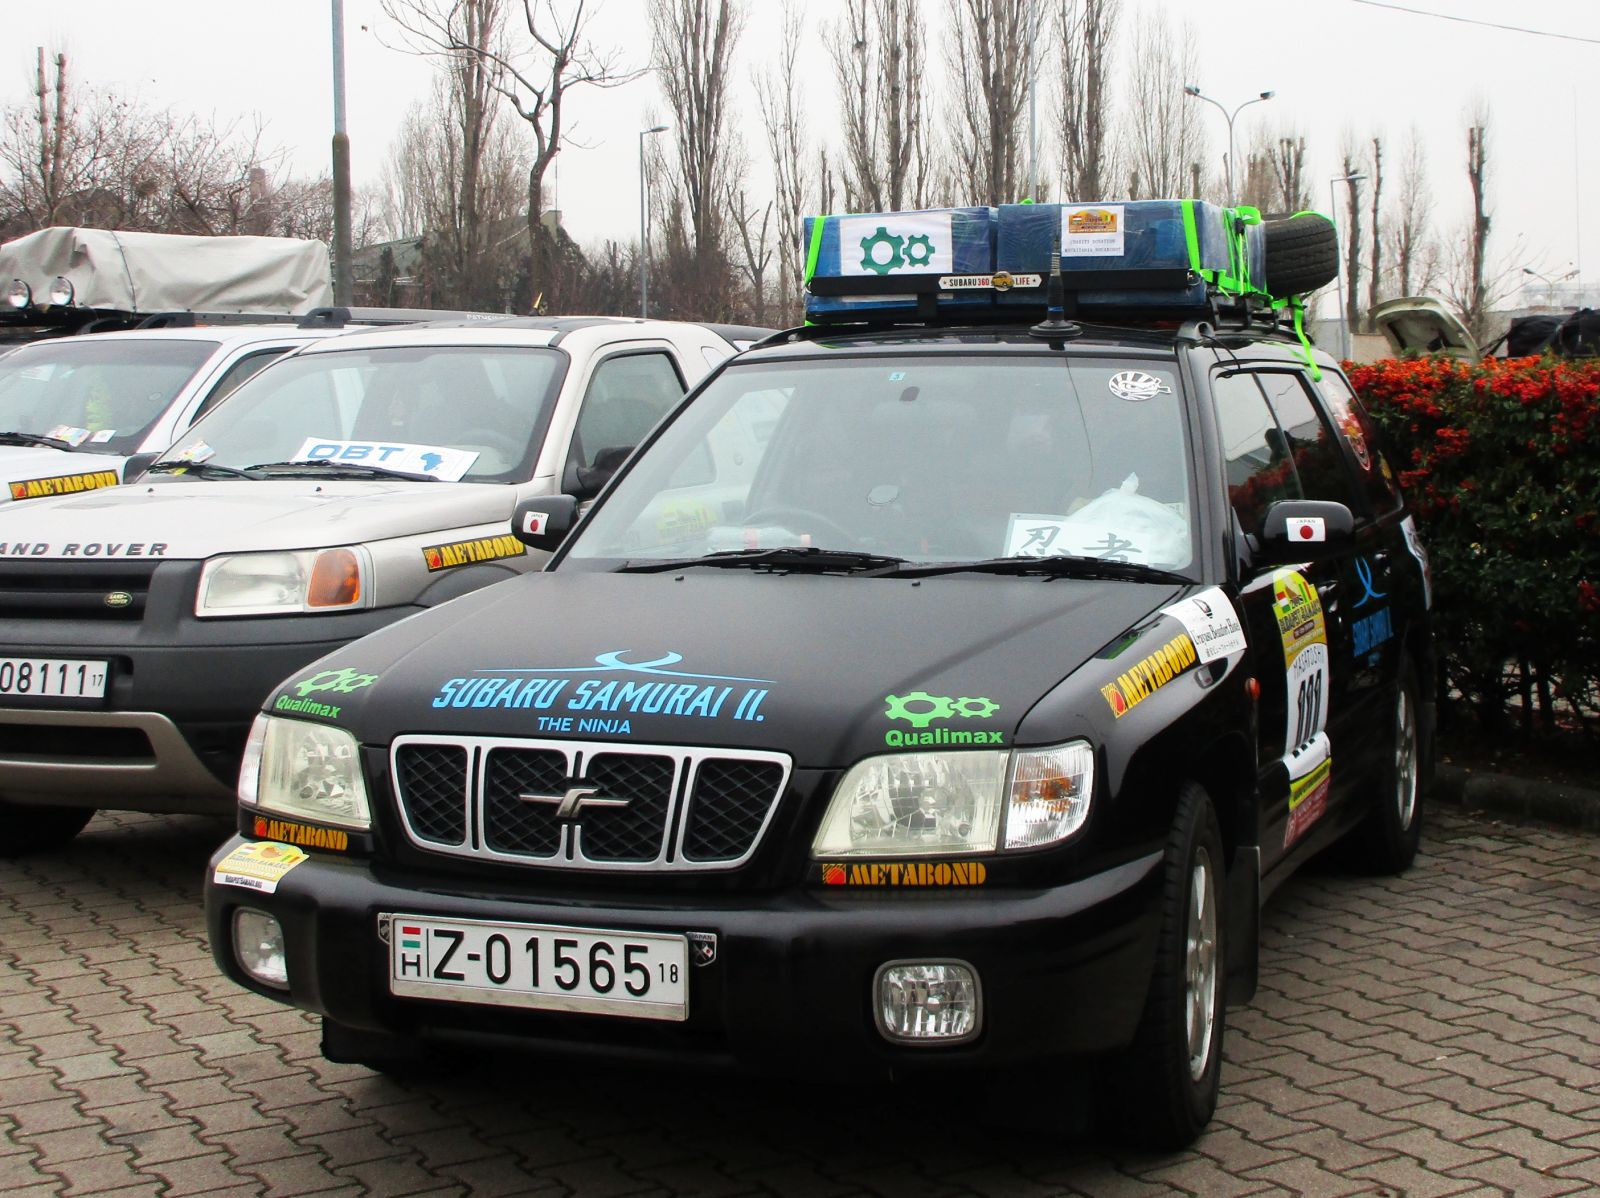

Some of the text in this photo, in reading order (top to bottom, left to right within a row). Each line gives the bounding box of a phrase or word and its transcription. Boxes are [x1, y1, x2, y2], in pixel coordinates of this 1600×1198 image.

[1015, 277, 1030, 286] LIFE
[307, 444, 404, 462] OBT
[27, 472, 118, 497] METABOND
[61, 543, 168, 557] ROVER
[440, 535, 525, 567] METABOND
[0, 661, 104, 695] 08111 17
[1117, 633, 1197, 710] METABOND
[276, 694, 342, 719] Qualimax
[432, 678, 769, 722] SUBARU SAMURAI II.
[537, 716, 632, 735] THE NINJA
[885, 728, 1004, 748] Qualimax
[267, 819, 349, 852] METABOND
[850, 862, 987, 885] METABOND
[401, 953, 421, 977] H
[433, 929, 679, 997] Z-01565 18
